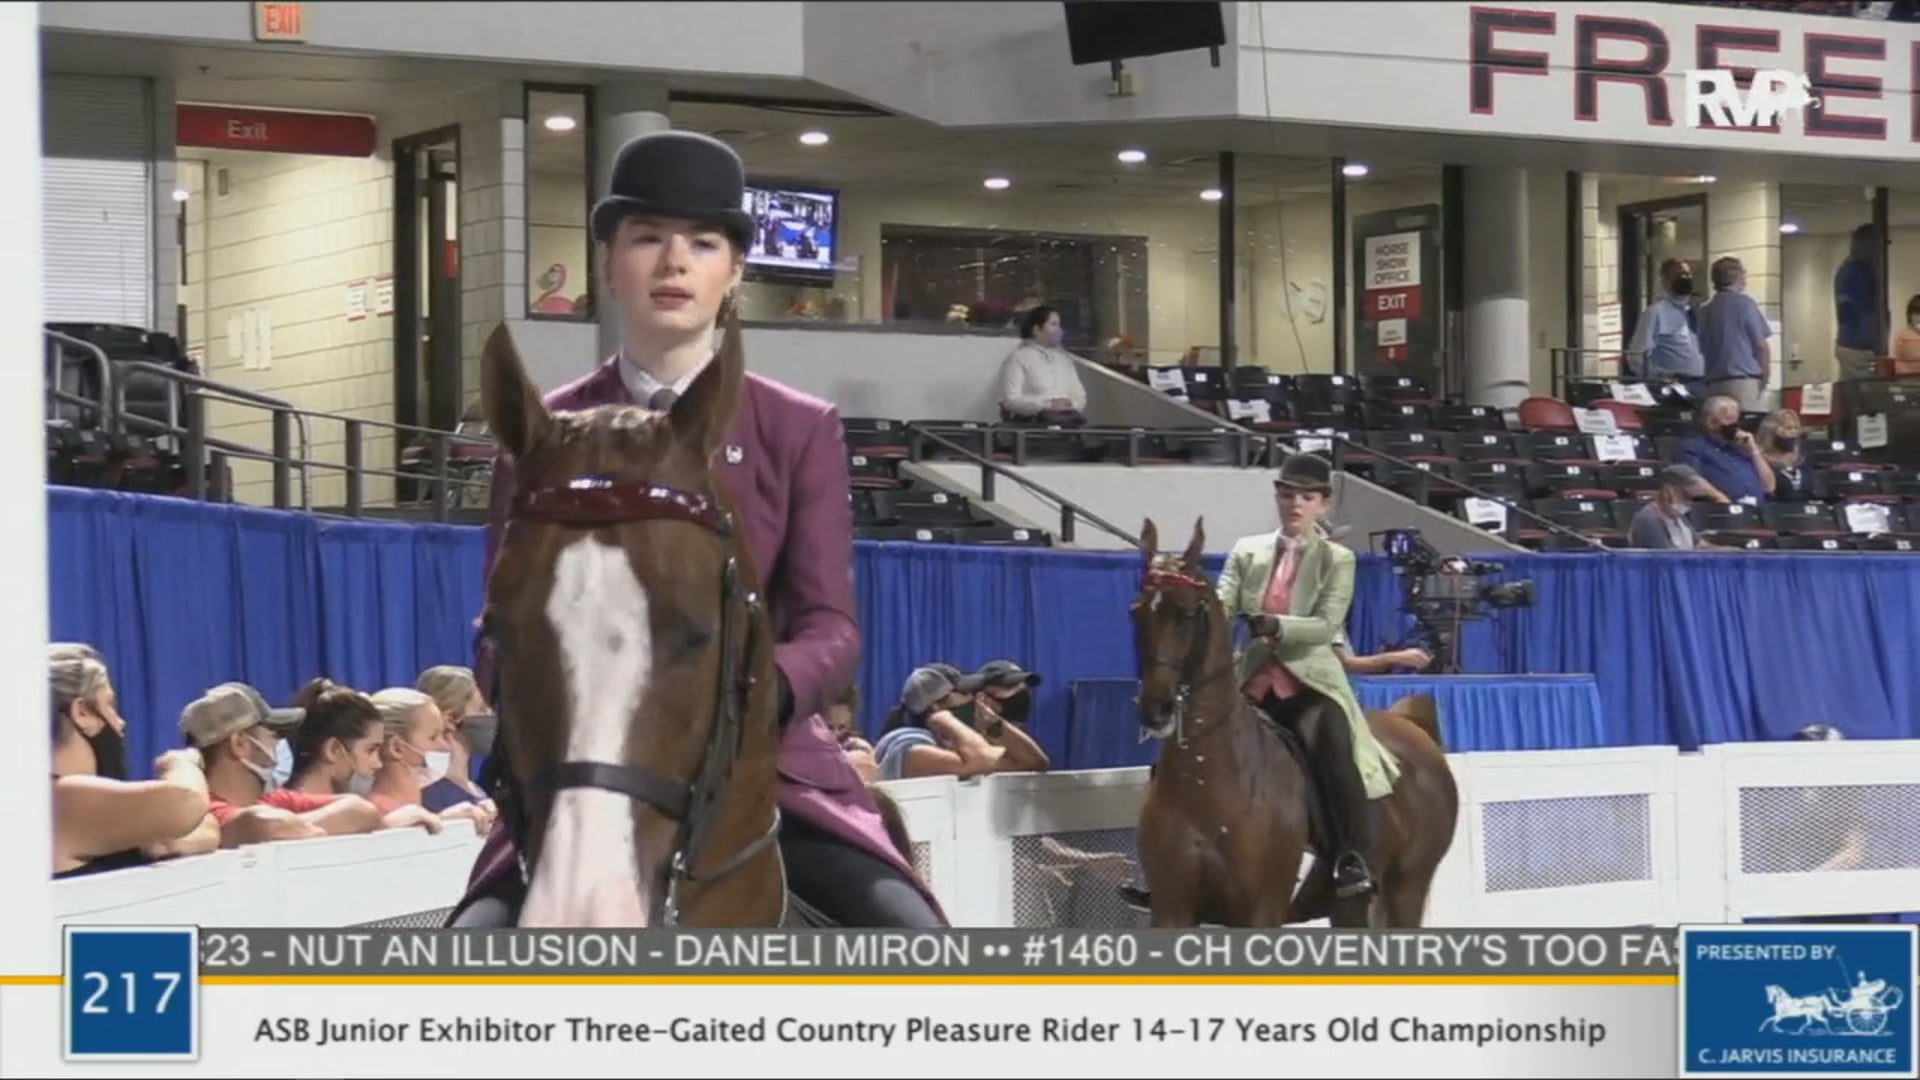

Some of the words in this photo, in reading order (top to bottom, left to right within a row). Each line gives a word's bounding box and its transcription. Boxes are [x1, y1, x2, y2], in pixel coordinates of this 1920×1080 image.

[263, 4, 303, 35] EXIT
[1470, 6, 1920, 142] FREE
[226, 119, 269, 141] Exit
[1376, 242, 1409, 256] HORSE
[1376, 257, 1408, 270] SHOW
[1375, 270, 1410, 285] OFFICE
[1378, 293, 1408, 311] EXIT
